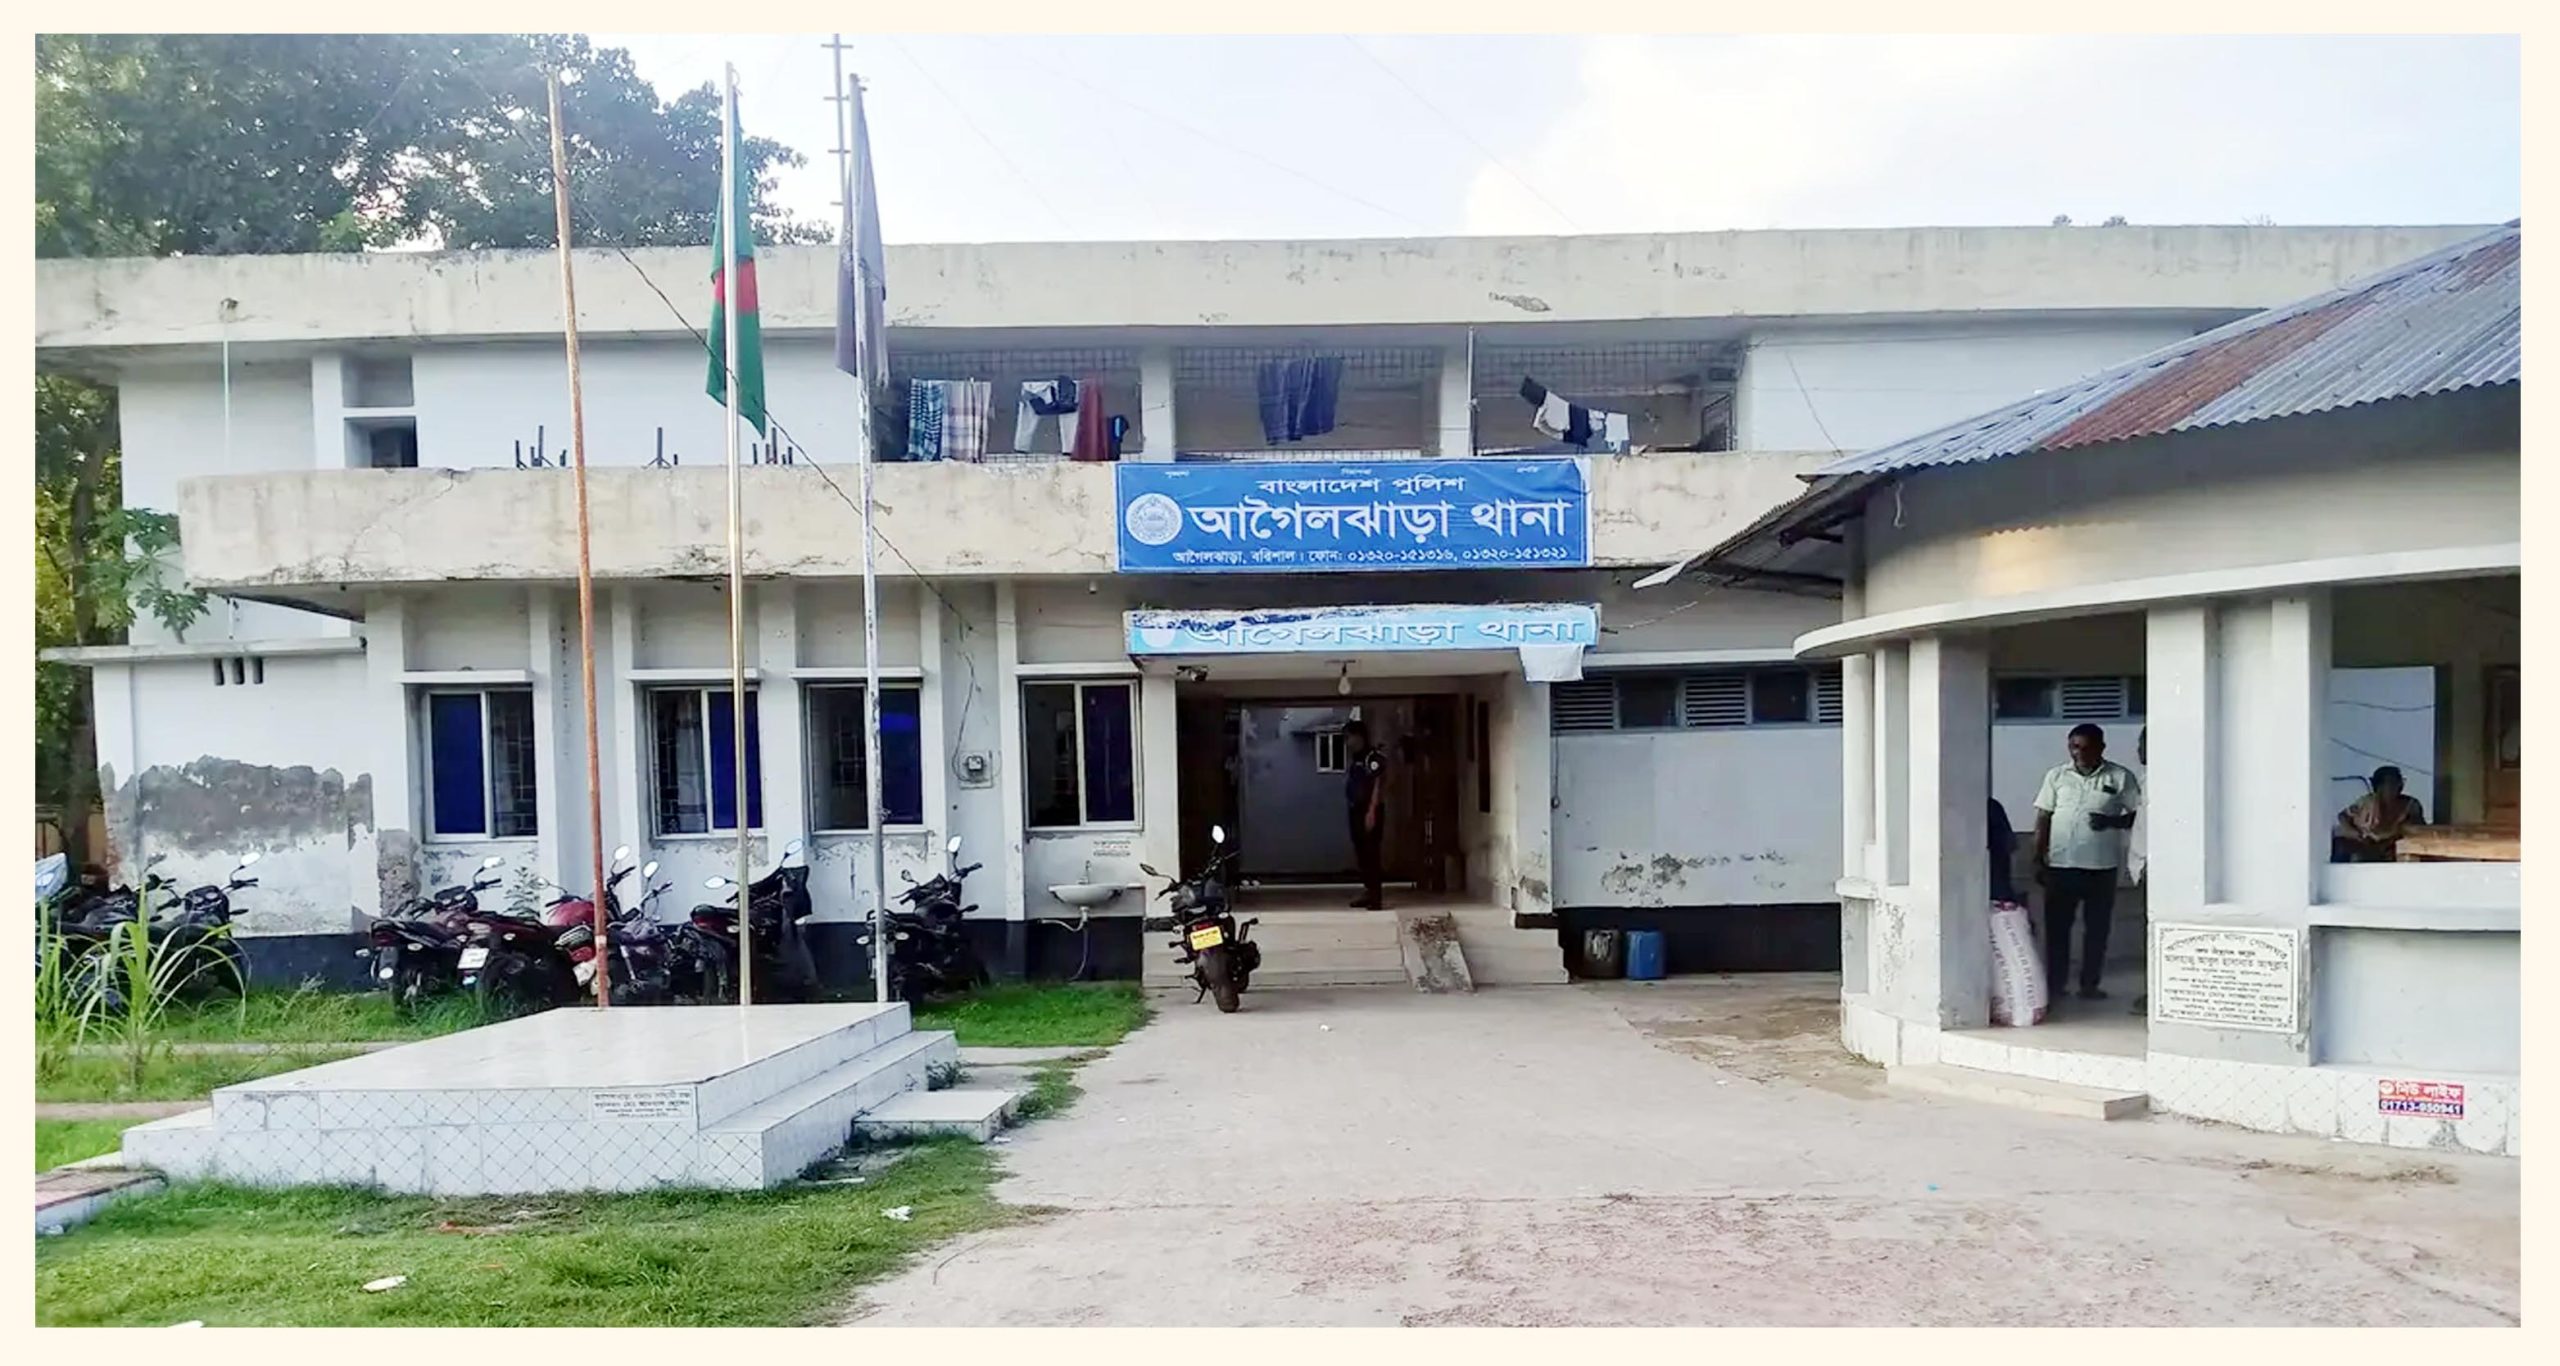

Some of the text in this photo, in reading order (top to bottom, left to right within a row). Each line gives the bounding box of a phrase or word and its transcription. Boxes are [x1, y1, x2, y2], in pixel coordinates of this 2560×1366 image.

[1256, 473, 1467, 497] বাংলাদেশ পুলিশ
[1186, 495, 1573, 544] আগৈলঝাড়া থানা
[1250, 547, 1297, 563] বরিশাল
[1462, 547, 1568, 561] ০১৩২০-১৫১৩২১
[1478, 620, 1585, 642] থানা
